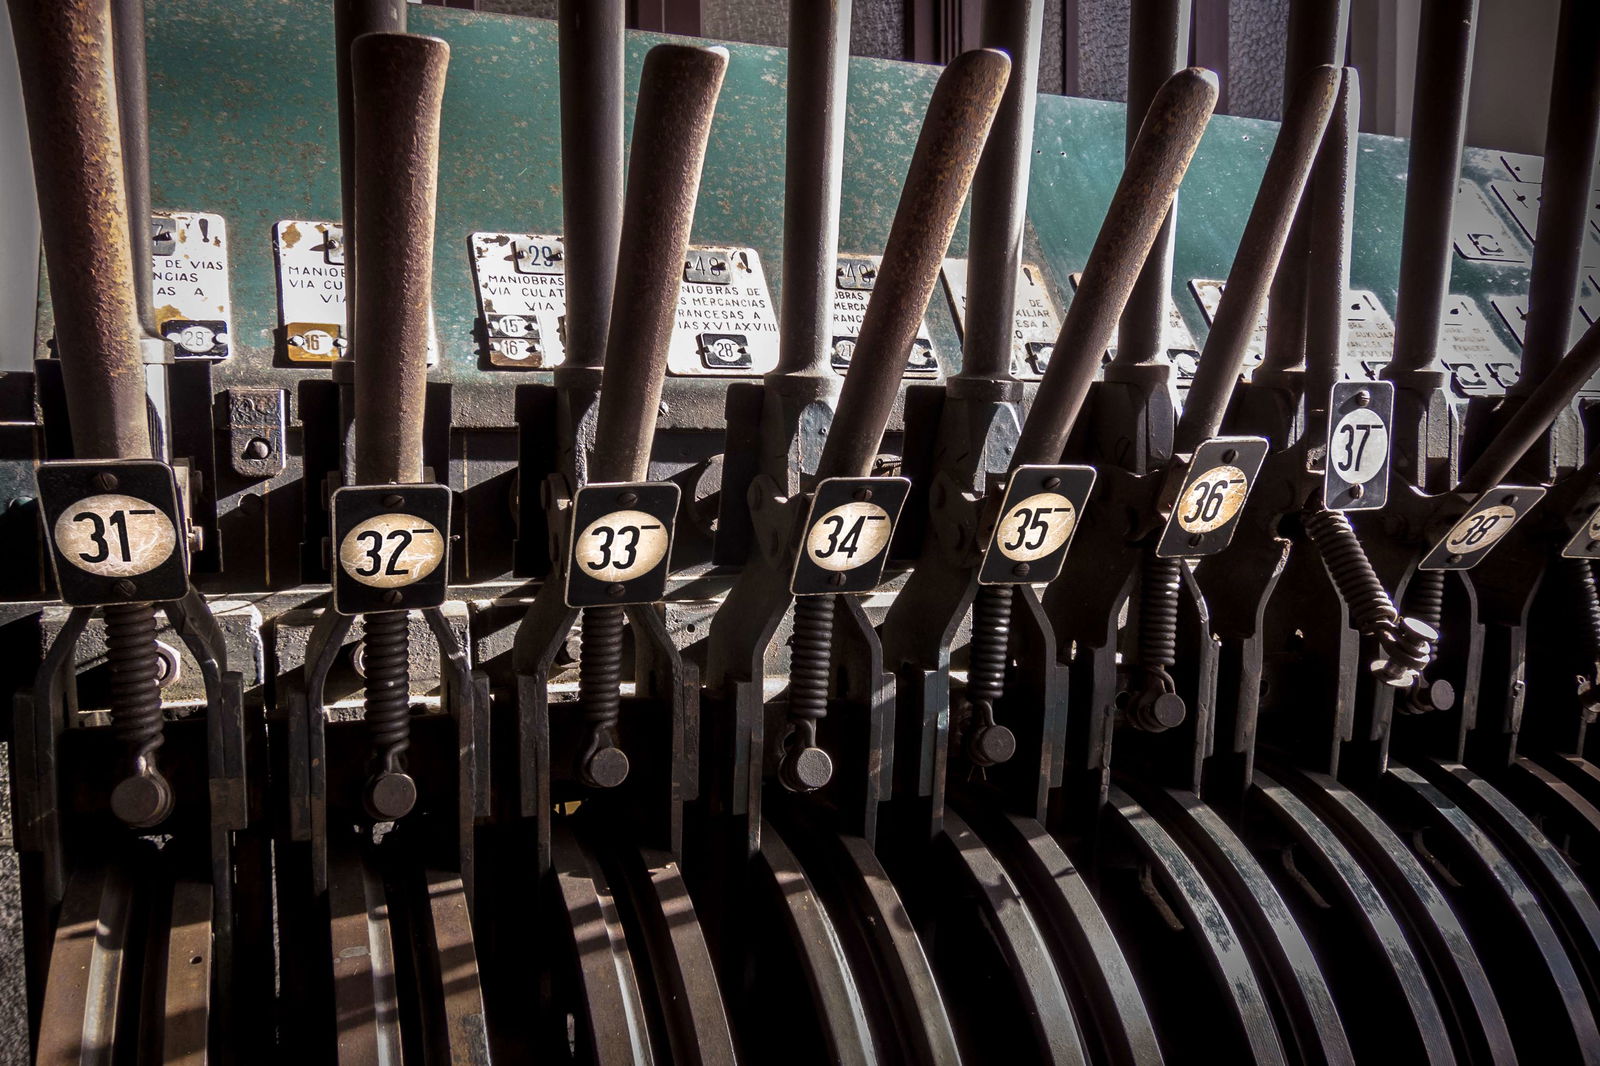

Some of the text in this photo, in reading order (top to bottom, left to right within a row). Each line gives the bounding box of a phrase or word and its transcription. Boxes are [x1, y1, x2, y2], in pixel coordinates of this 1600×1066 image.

[165, 260, 182, 268] DE
[190, 261, 223, 270] VIAS
[289, 280, 315, 288] VIA
[488, 275, 564, 285] MANIOBRAS
[194, 288, 204, 296] A
[488, 288, 511, 296] VIA
[747, 288, 760, 296] DE
[524, 301, 555, 311] VIA
[692, 297, 766, 308] MERCANCIAS
[1028, 299, 1043, 308] DE
[753, 311, 761, 319] A
[1042, 320, 1050, 328] A
